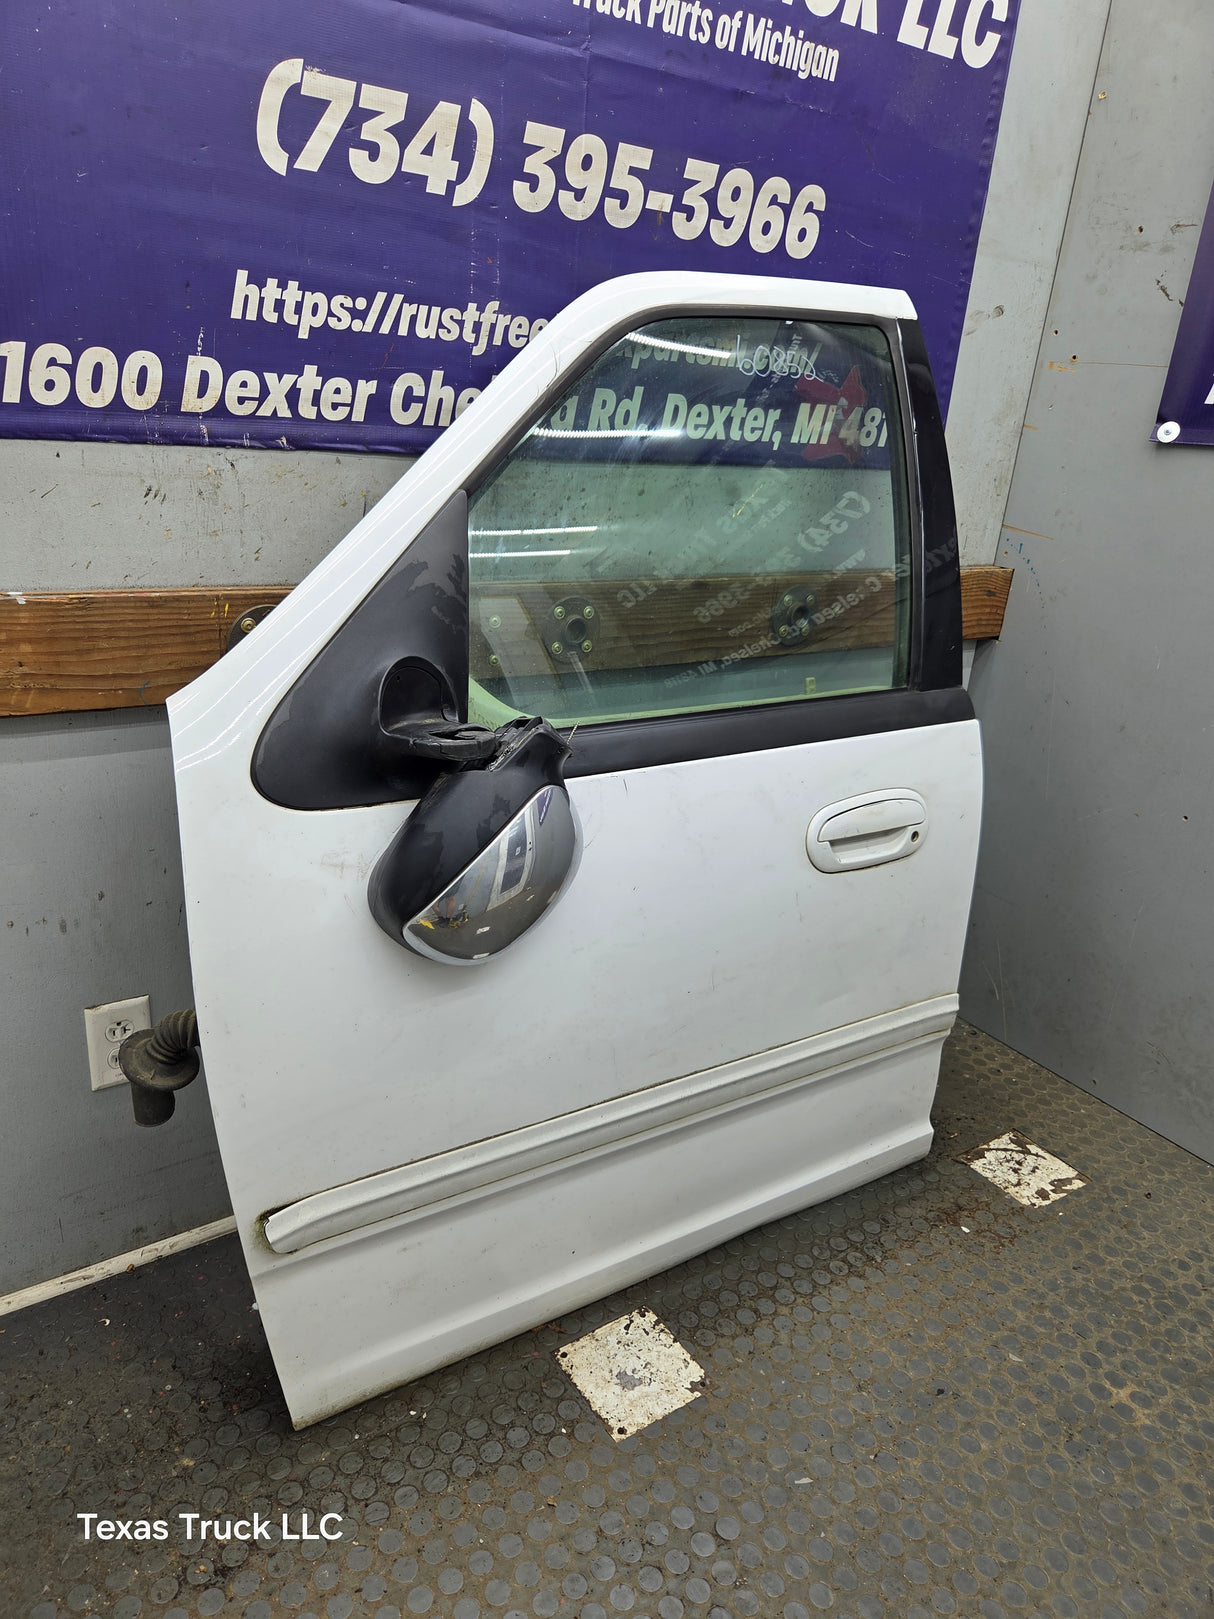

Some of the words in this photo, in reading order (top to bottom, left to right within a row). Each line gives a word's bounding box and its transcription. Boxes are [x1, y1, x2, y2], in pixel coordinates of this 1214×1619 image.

[572, 0, 641, 25] uck
[646, 0, 714, 45] Parts
[714, 10, 743, 52] of
[741, 13, 840, 82] Michigan
[256, 58, 495, 207] (734)
[512, 120, 827, 260] 395-3966
[0, 340, 163, 411] 1600
[181, 352, 378, 422] Dexter
[661, 393, 782, 451] Dexter,
[790, 402, 838, 445] MI
[838, 406, 888, 448] 481
